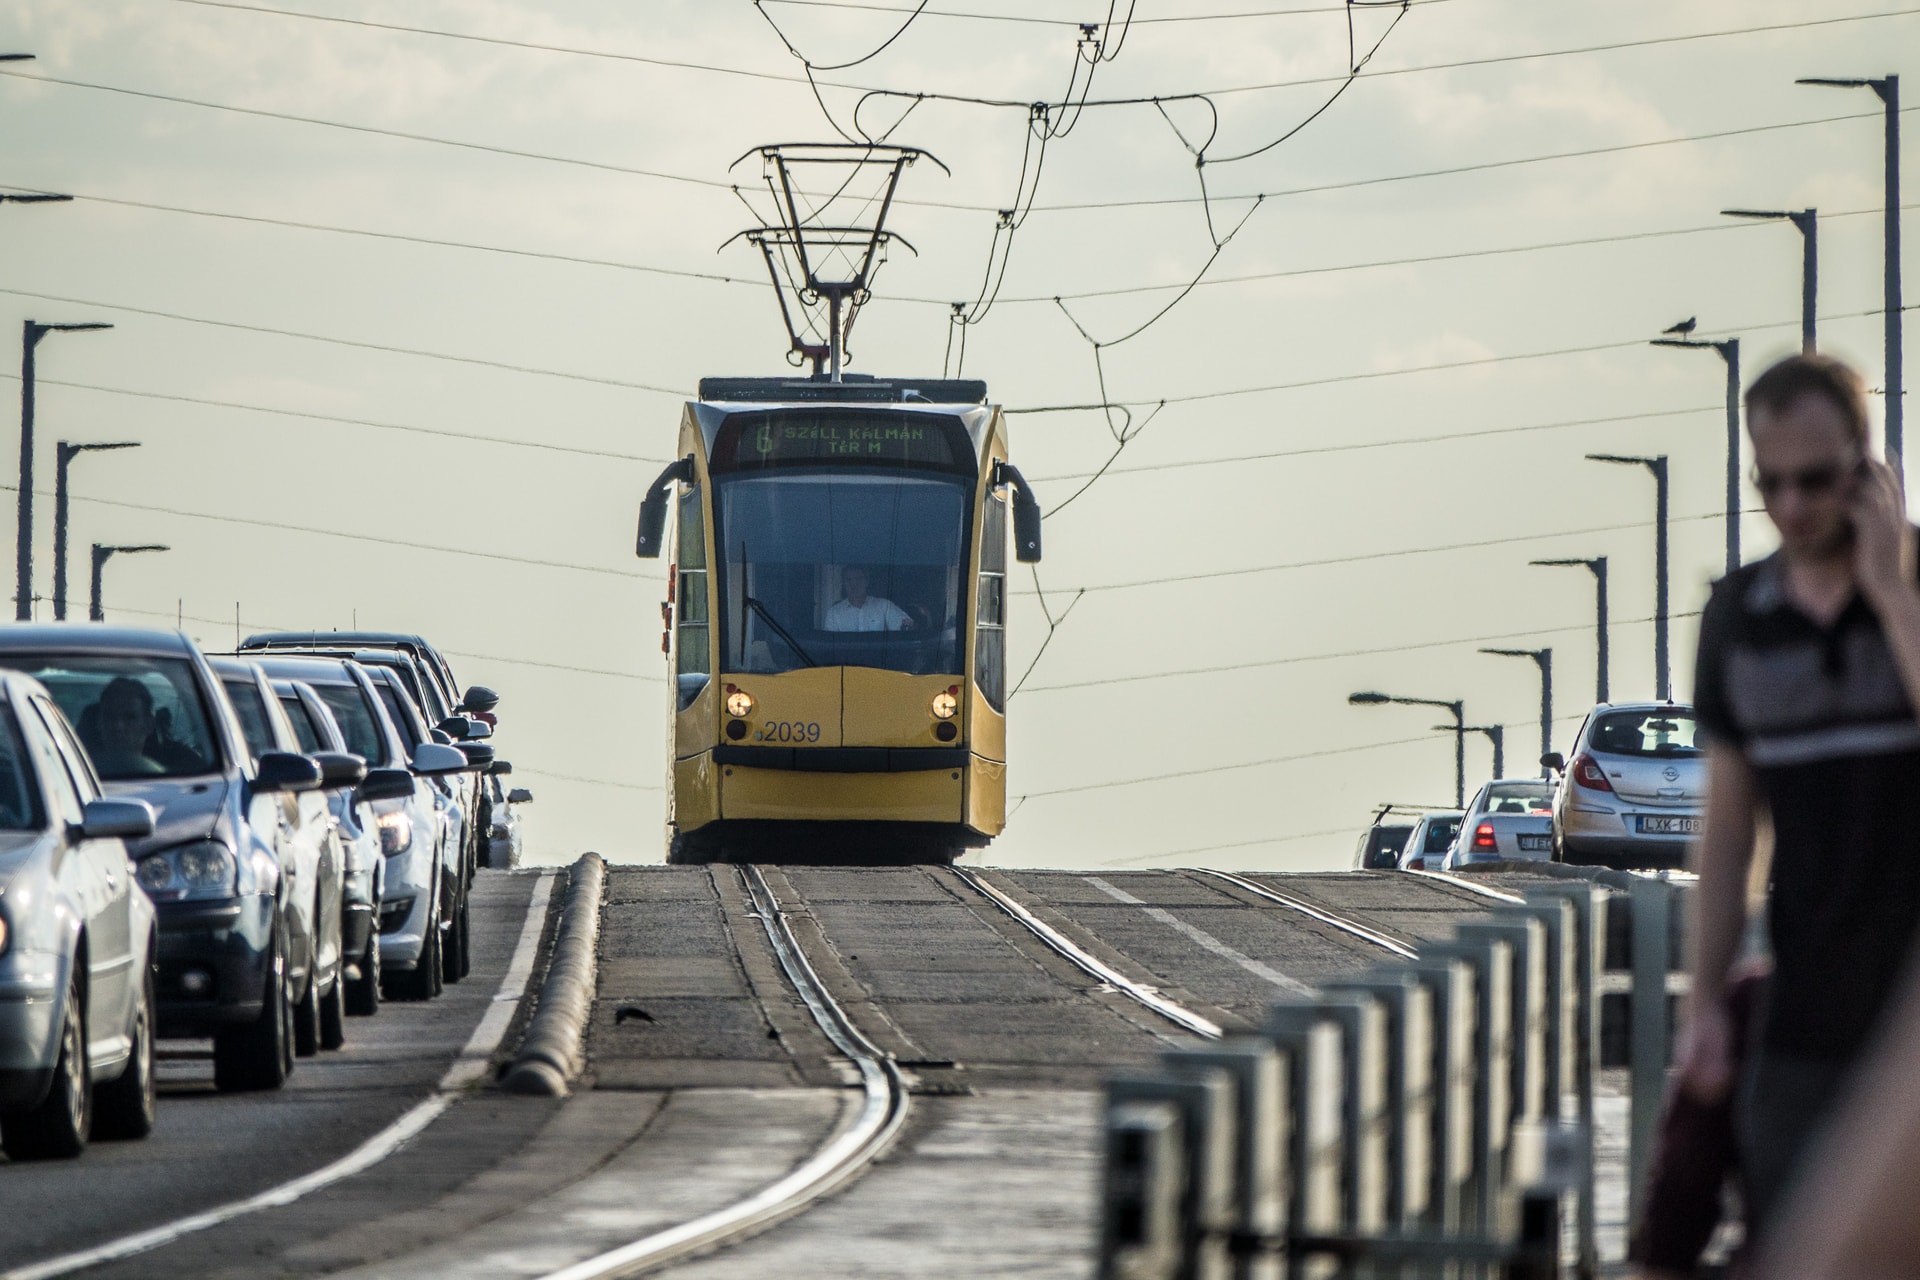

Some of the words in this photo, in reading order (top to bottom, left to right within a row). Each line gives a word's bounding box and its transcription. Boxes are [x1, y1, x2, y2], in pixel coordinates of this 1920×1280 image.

[756, 426, 773, 453] 6
[849, 426, 923, 440] KÁLMÁN
[868, 441, 881, 454] M
[764, 721, 820, 743] 2039
